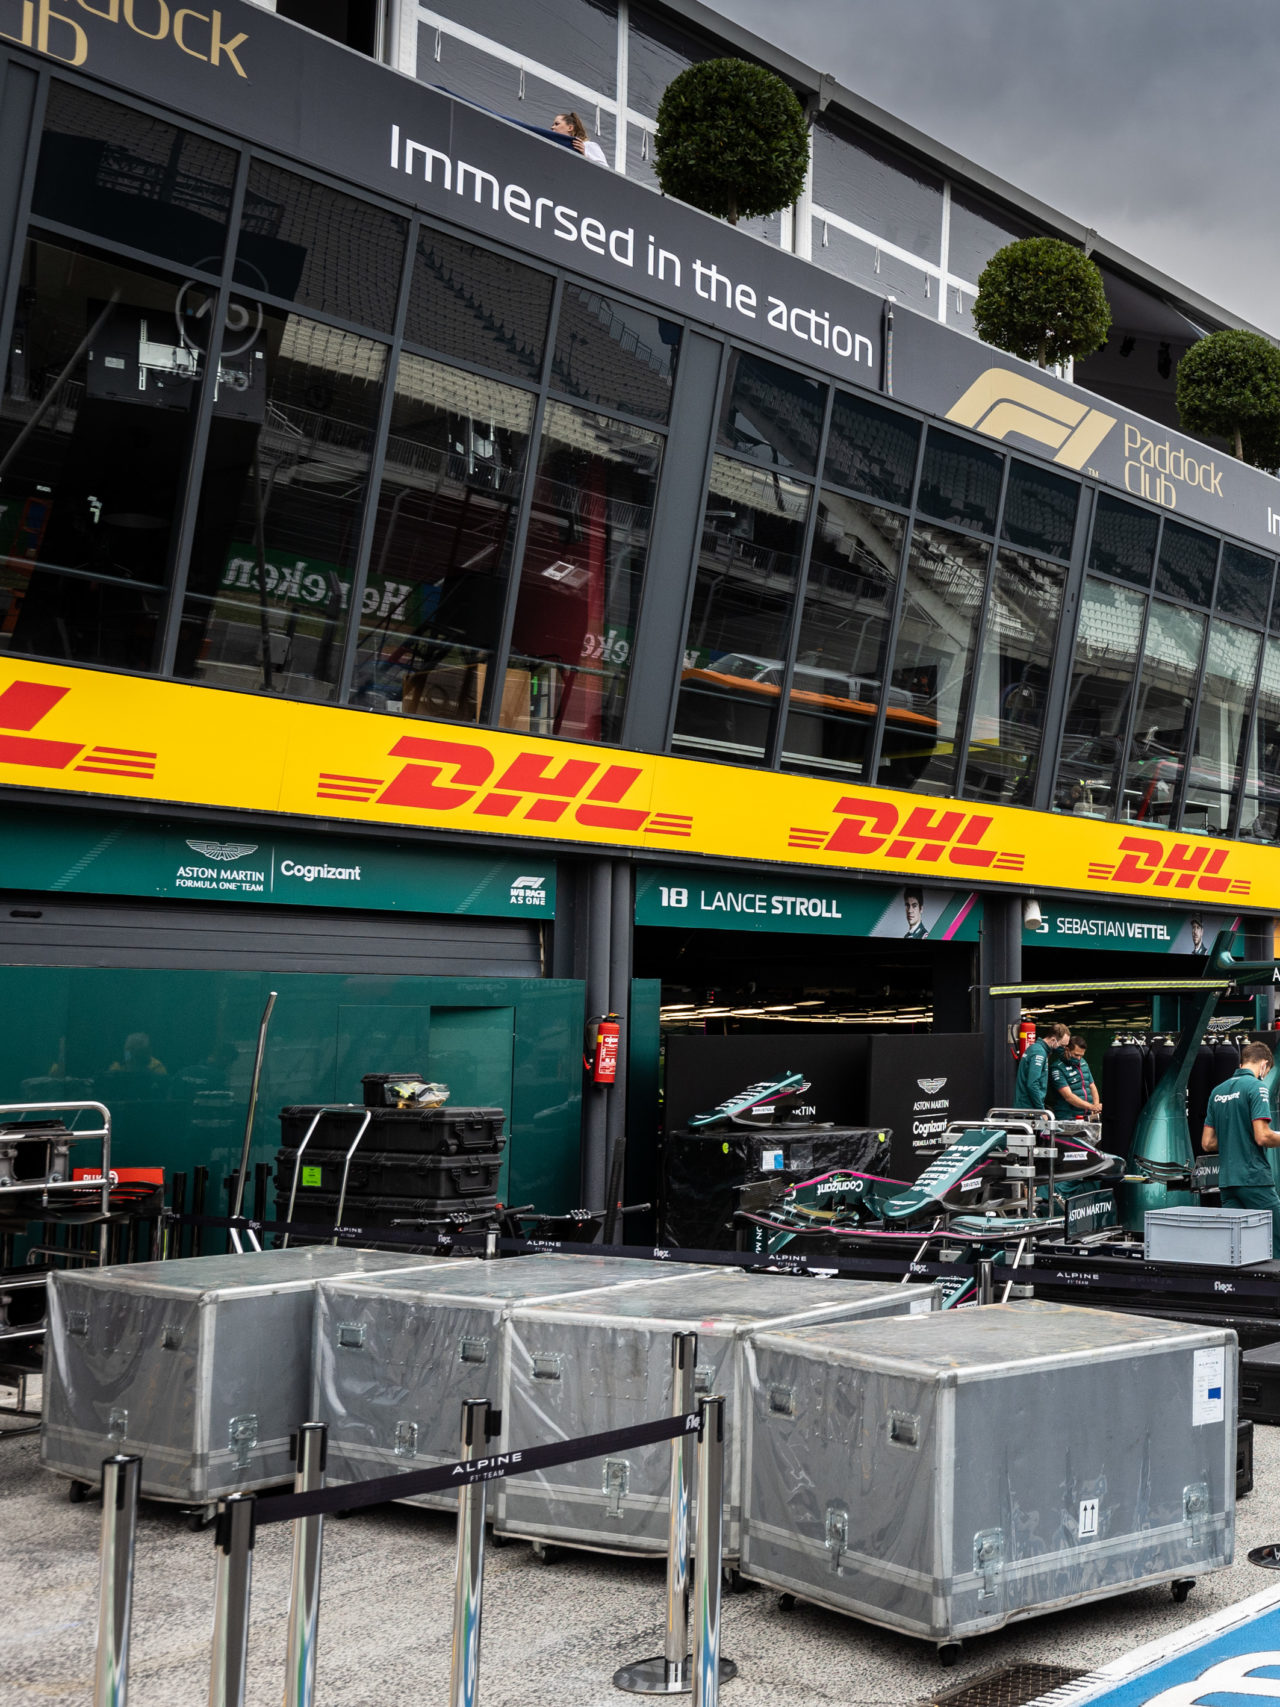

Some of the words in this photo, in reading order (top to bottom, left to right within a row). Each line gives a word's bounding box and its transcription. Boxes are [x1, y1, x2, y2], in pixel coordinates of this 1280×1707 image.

[391, 125, 634, 267] Immersed
[648, 235, 681, 288] in
[692, 259, 756, 318] the
[767, 296, 873, 368] action
[1124, 423, 1224, 497] Paddock
[1125, 461, 1177, 509] Club
[376, 736, 651, 832] DHL
[824, 797, 998, 868] DHL
[177, 866, 217, 878] ASTON
[220, 869, 264, 881] MARTIN
[281, 860, 361, 882] Cognizant
[1112, 837, 1233, 893] DHL
[176, 879, 217, 888] FORMULA
[241, 883, 264, 892] TEAM
[510, 896, 523, 904] AS
[526, 897, 546, 906] ONE
[659, 887, 688, 907] 18
[701, 891, 767, 913] LANCE
[771, 896, 842, 918] STROLL
[1035, 915, 1049, 933] 5
[1057, 917, 1125, 937] SEBASTIAN
[1127, 922, 1171, 940] VETTEL
[793, 1106, 816, 1117] RTIN
[913, 1101, 930, 1111] ASTON
[930, 1099, 949, 1110] MARTIN
[912, 1119, 947, 1137] Cognizant
[1069, 1205, 1088, 1222] ASTON
[1088, 1202, 1112, 1219] MARTIN
[333, 1226, 363, 1234] ALPINE
[526, 1240, 562, 1248] ALPINE
[769, 1254, 807, 1262] ALPINE
[1057, 1271, 1100, 1280] ALPINE
[452, 1452, 522, 1475] ALPINE
[482, 1469, 504, 1479] TEAM
